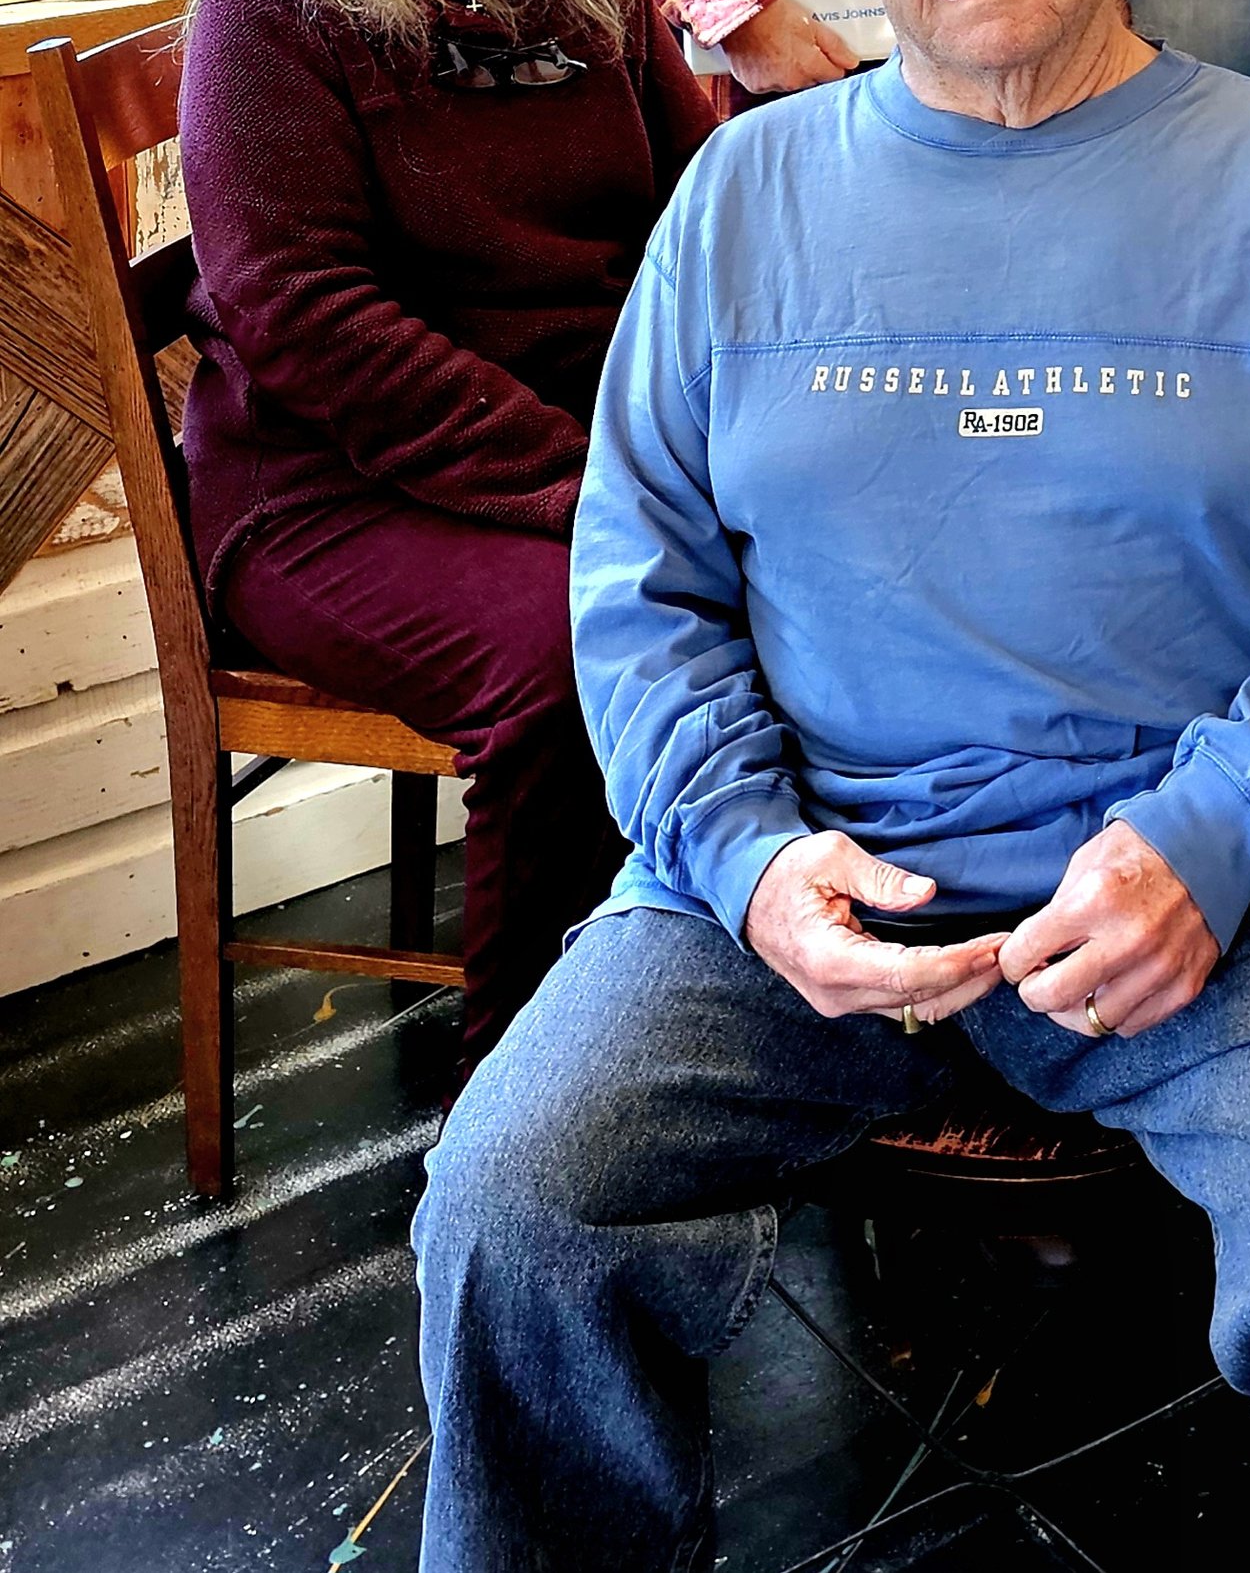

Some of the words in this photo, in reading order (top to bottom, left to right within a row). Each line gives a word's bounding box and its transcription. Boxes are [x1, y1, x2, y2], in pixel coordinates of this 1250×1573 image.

[811, 365, 975, 396] RUSSELL
[992, 365, 1191, 398] ATHLETIC
[963, 411, 1039, 433] RA-1902
